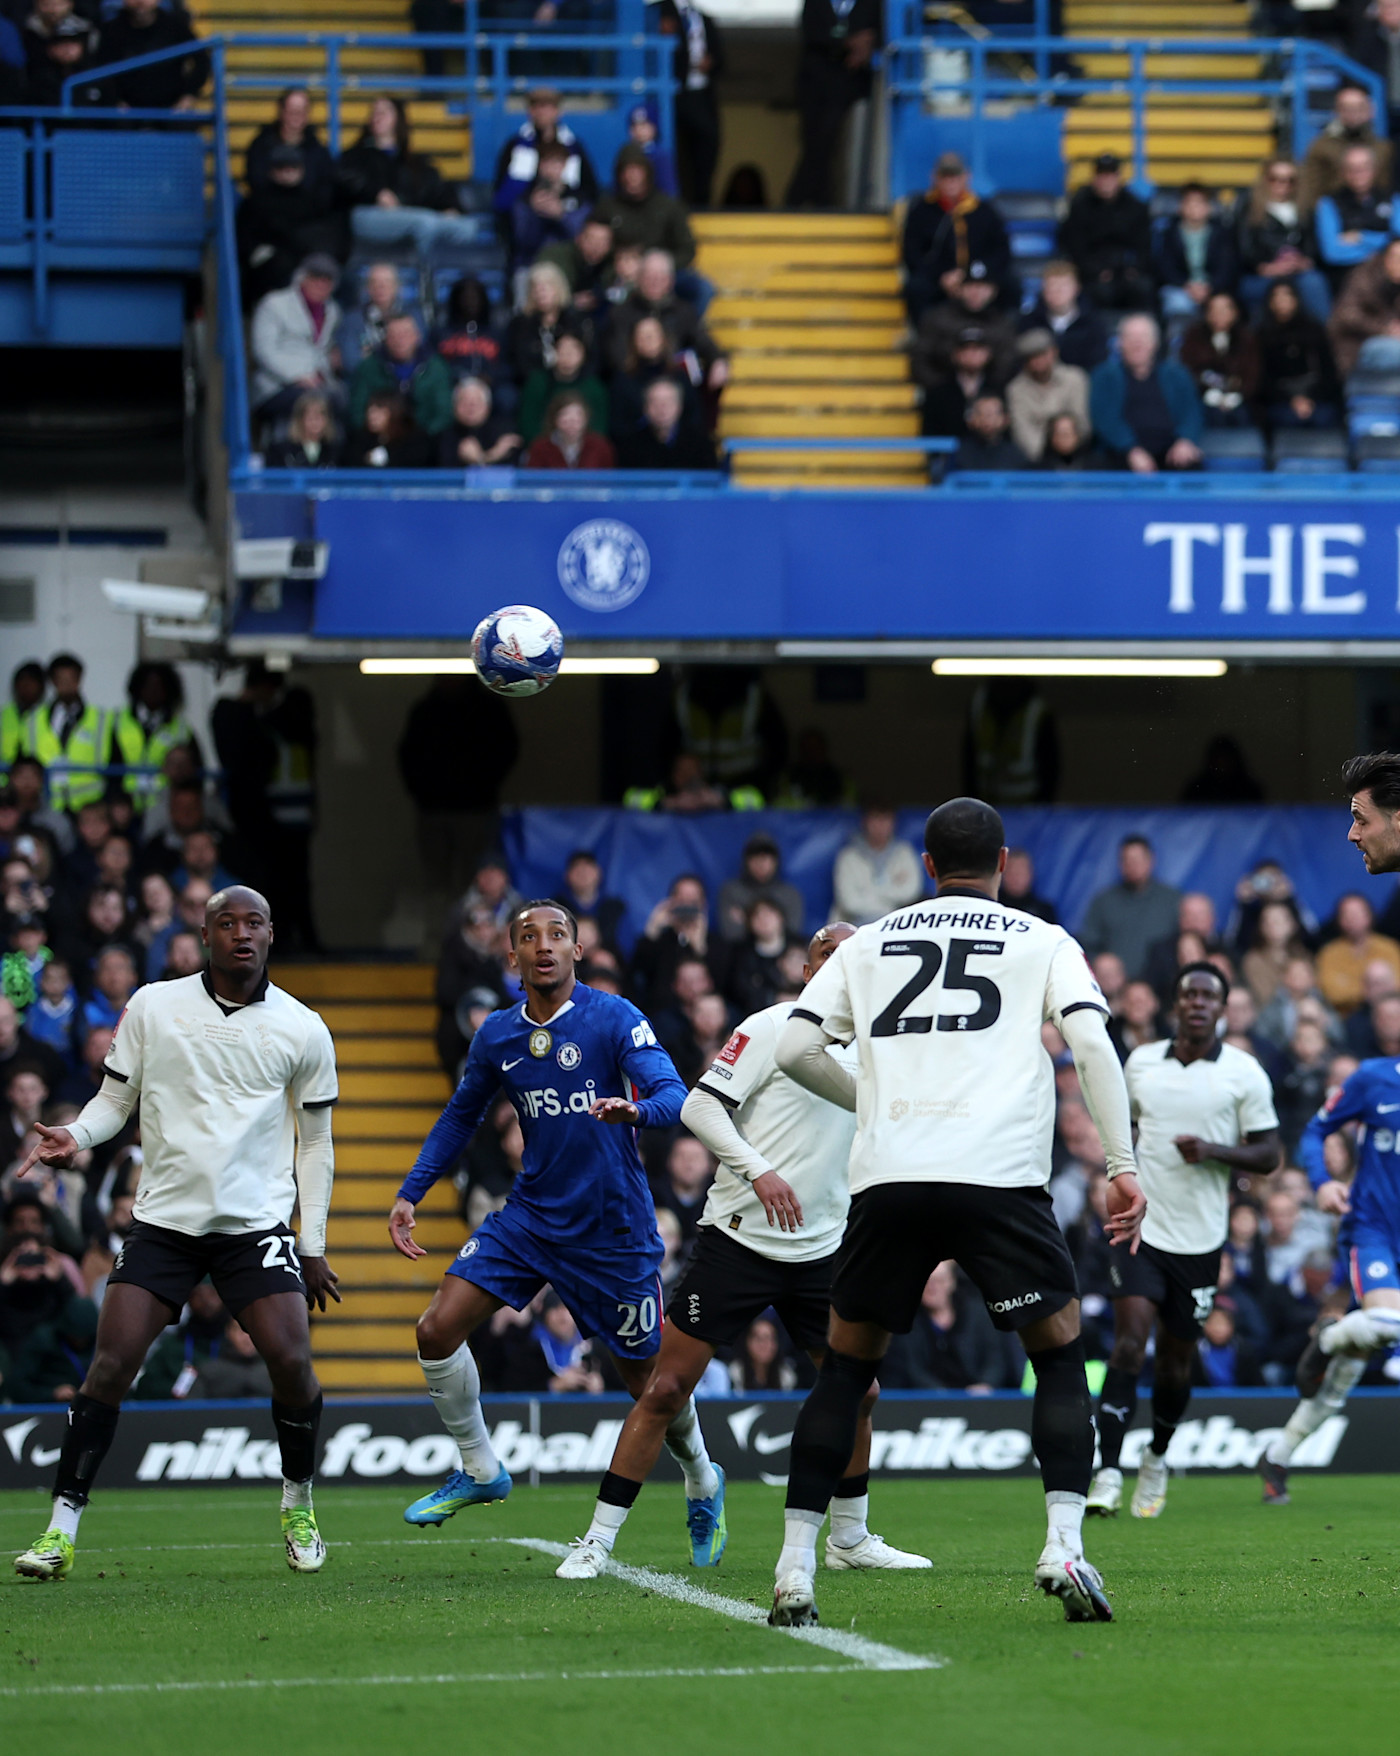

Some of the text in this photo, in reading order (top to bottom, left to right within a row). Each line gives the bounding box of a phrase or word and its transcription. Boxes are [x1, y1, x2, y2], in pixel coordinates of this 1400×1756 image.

[1144, 521, 1366, 614] THE
[881, 912, 1032, 933] HUMPHREYS
[870, 938, 1005, 1038] 25
[525, 1079, 596, 1118] IFS.ai
[617, 1296, 656, 1336] 20
[320, 1419, 626, 1478] fooball
[870, 1416, 1032, 1470] nike
